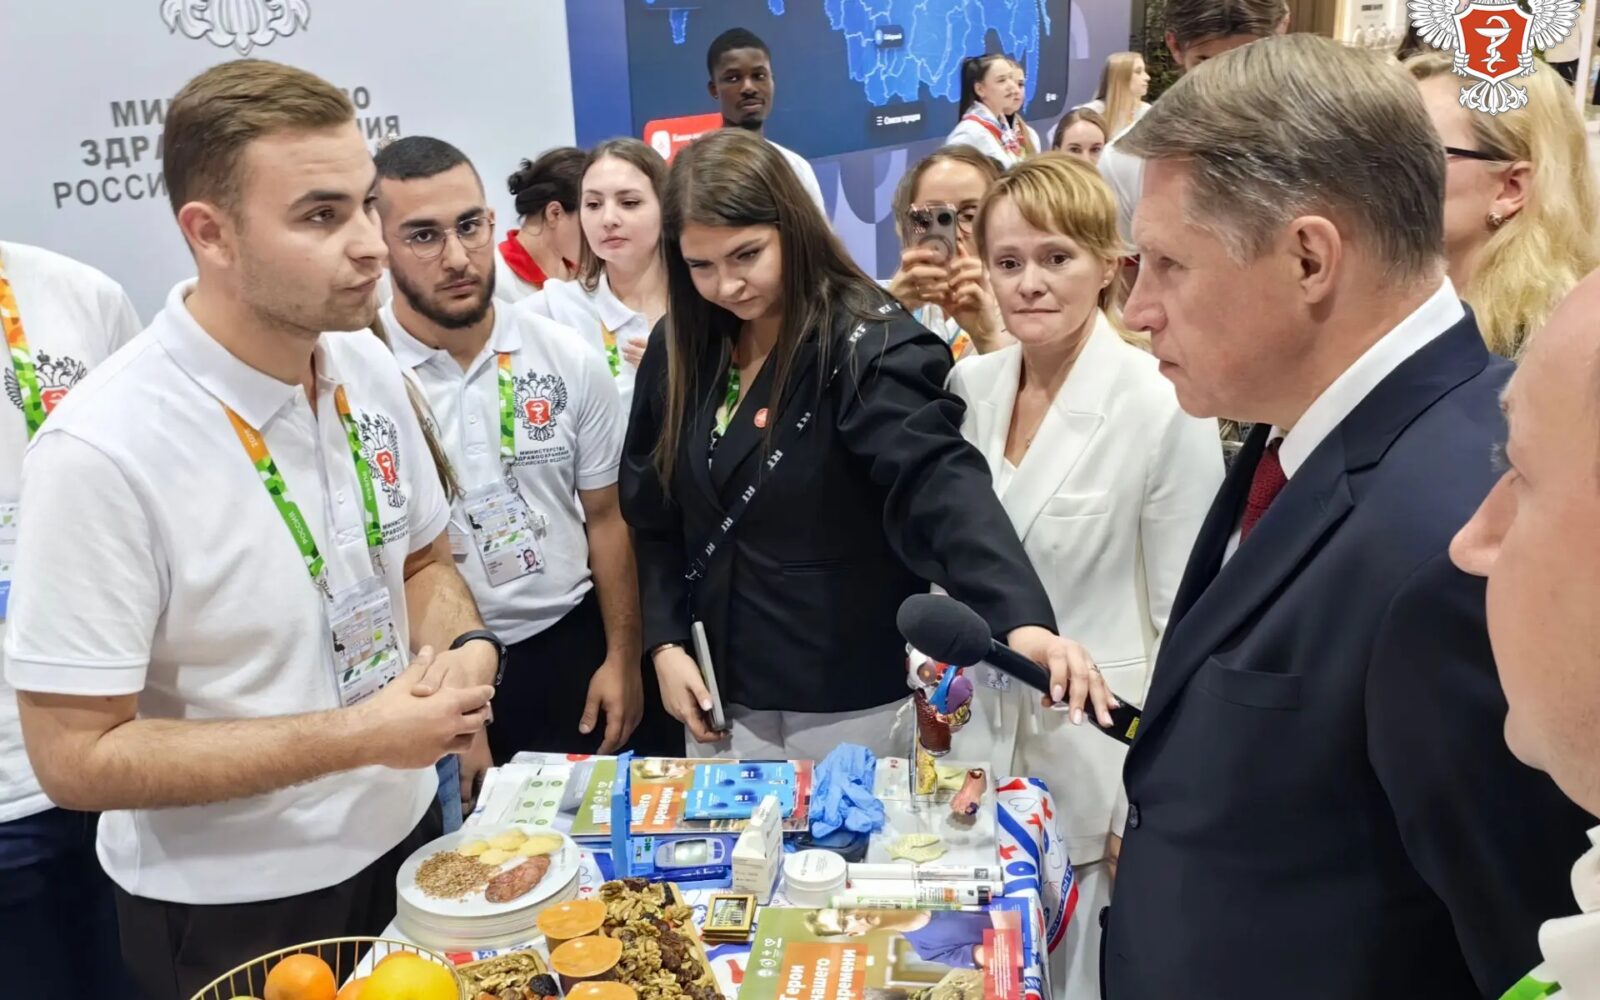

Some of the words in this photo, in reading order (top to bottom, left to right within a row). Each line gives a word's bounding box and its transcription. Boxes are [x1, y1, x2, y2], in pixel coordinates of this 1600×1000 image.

[766, 449, 784, 472] RT
[741, 485, 757, 505] RT
[720, 516, 734, 534] RT
